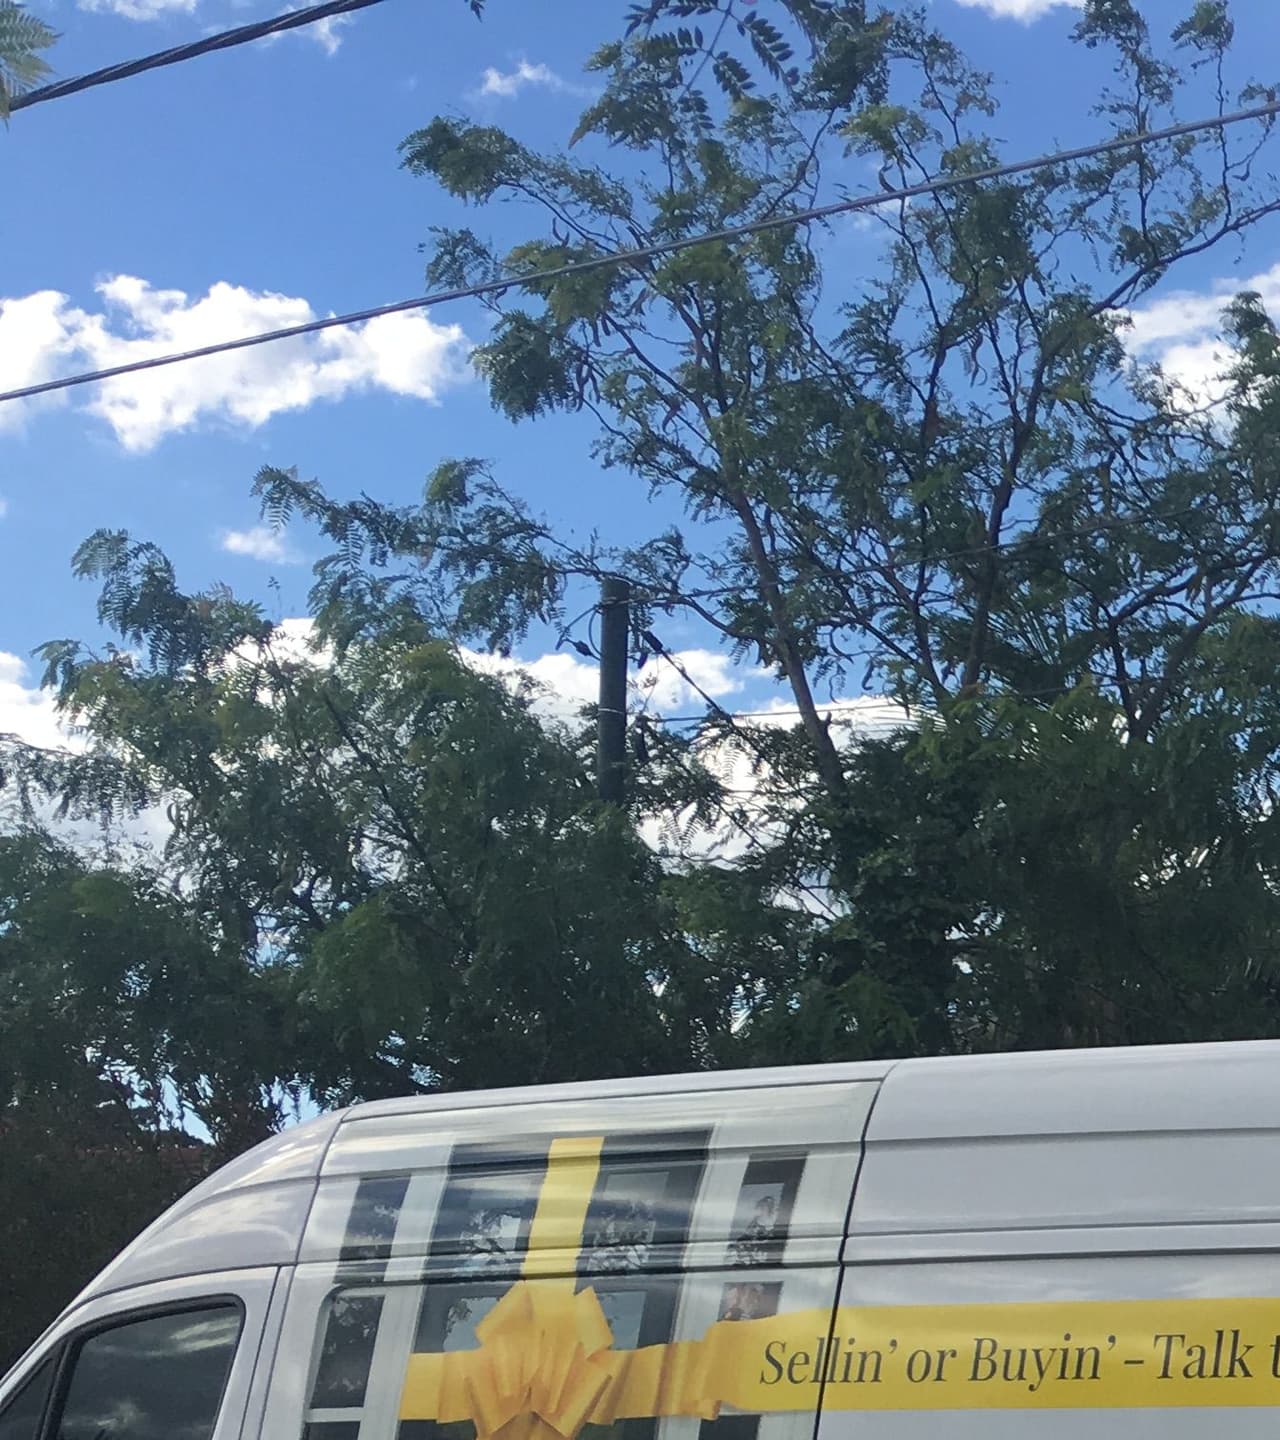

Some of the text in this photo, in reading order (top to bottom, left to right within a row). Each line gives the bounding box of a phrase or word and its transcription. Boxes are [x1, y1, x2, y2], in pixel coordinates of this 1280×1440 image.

[759, 1336, 898, 1385] Sellin'
[905, 1348, 957, 1384] or
[967, 1332, 1117, 1392] Buyin'
